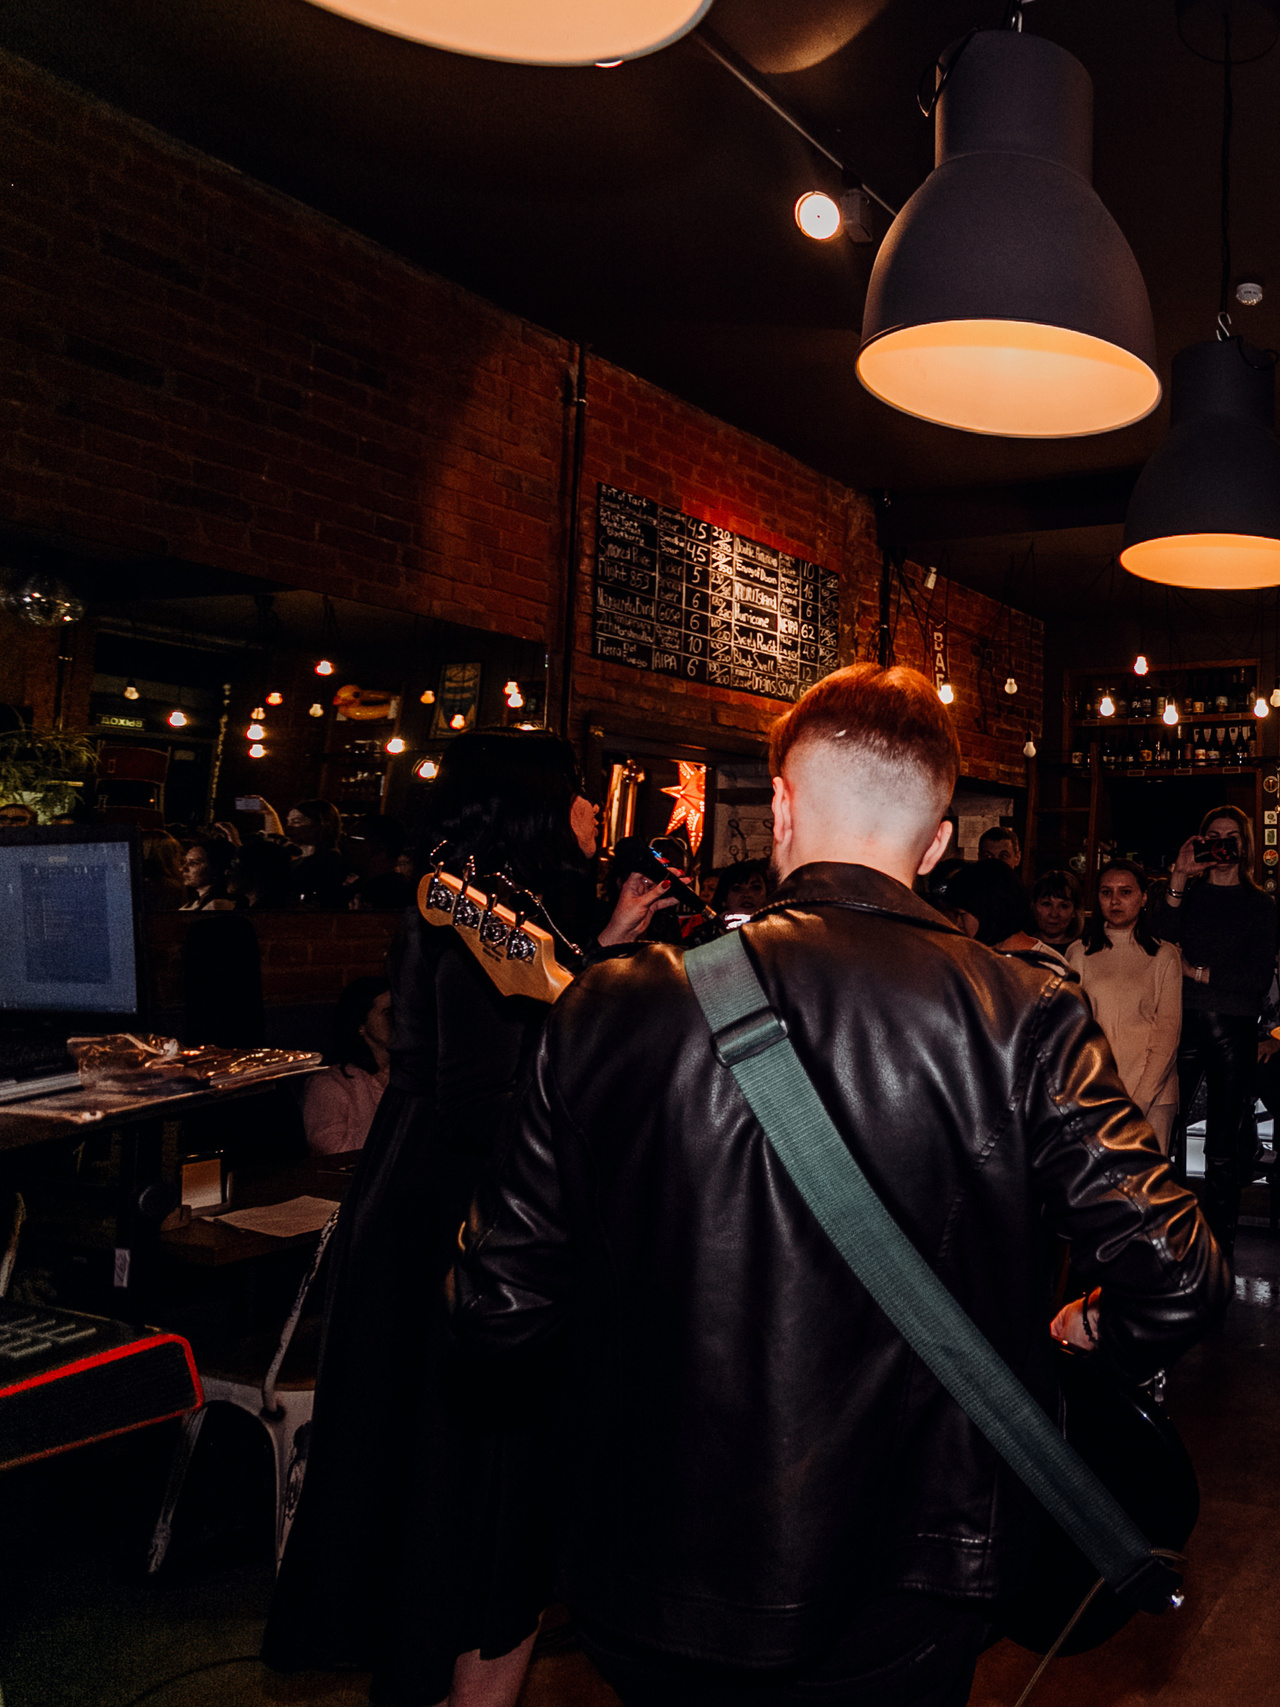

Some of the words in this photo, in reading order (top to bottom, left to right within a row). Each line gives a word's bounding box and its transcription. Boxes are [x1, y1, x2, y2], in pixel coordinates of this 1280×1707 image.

[712, 526, 731, 540] 220
[691, 566, 703, 583] 5
[803, 562, 815, 579] 10
[629, 570, 650, 590] 853
[803, 583, 814, 599] 16
[691, 592, 701, 608] 6
[806, 605, 813, 617] 6
[689, 613, 701, 630] 6
[596, 636, 622, 657] Tierra
[687, 636, 702, 654] 10
[686, 658, 699, 677] 6
[803, 667, 812, 681] 12
